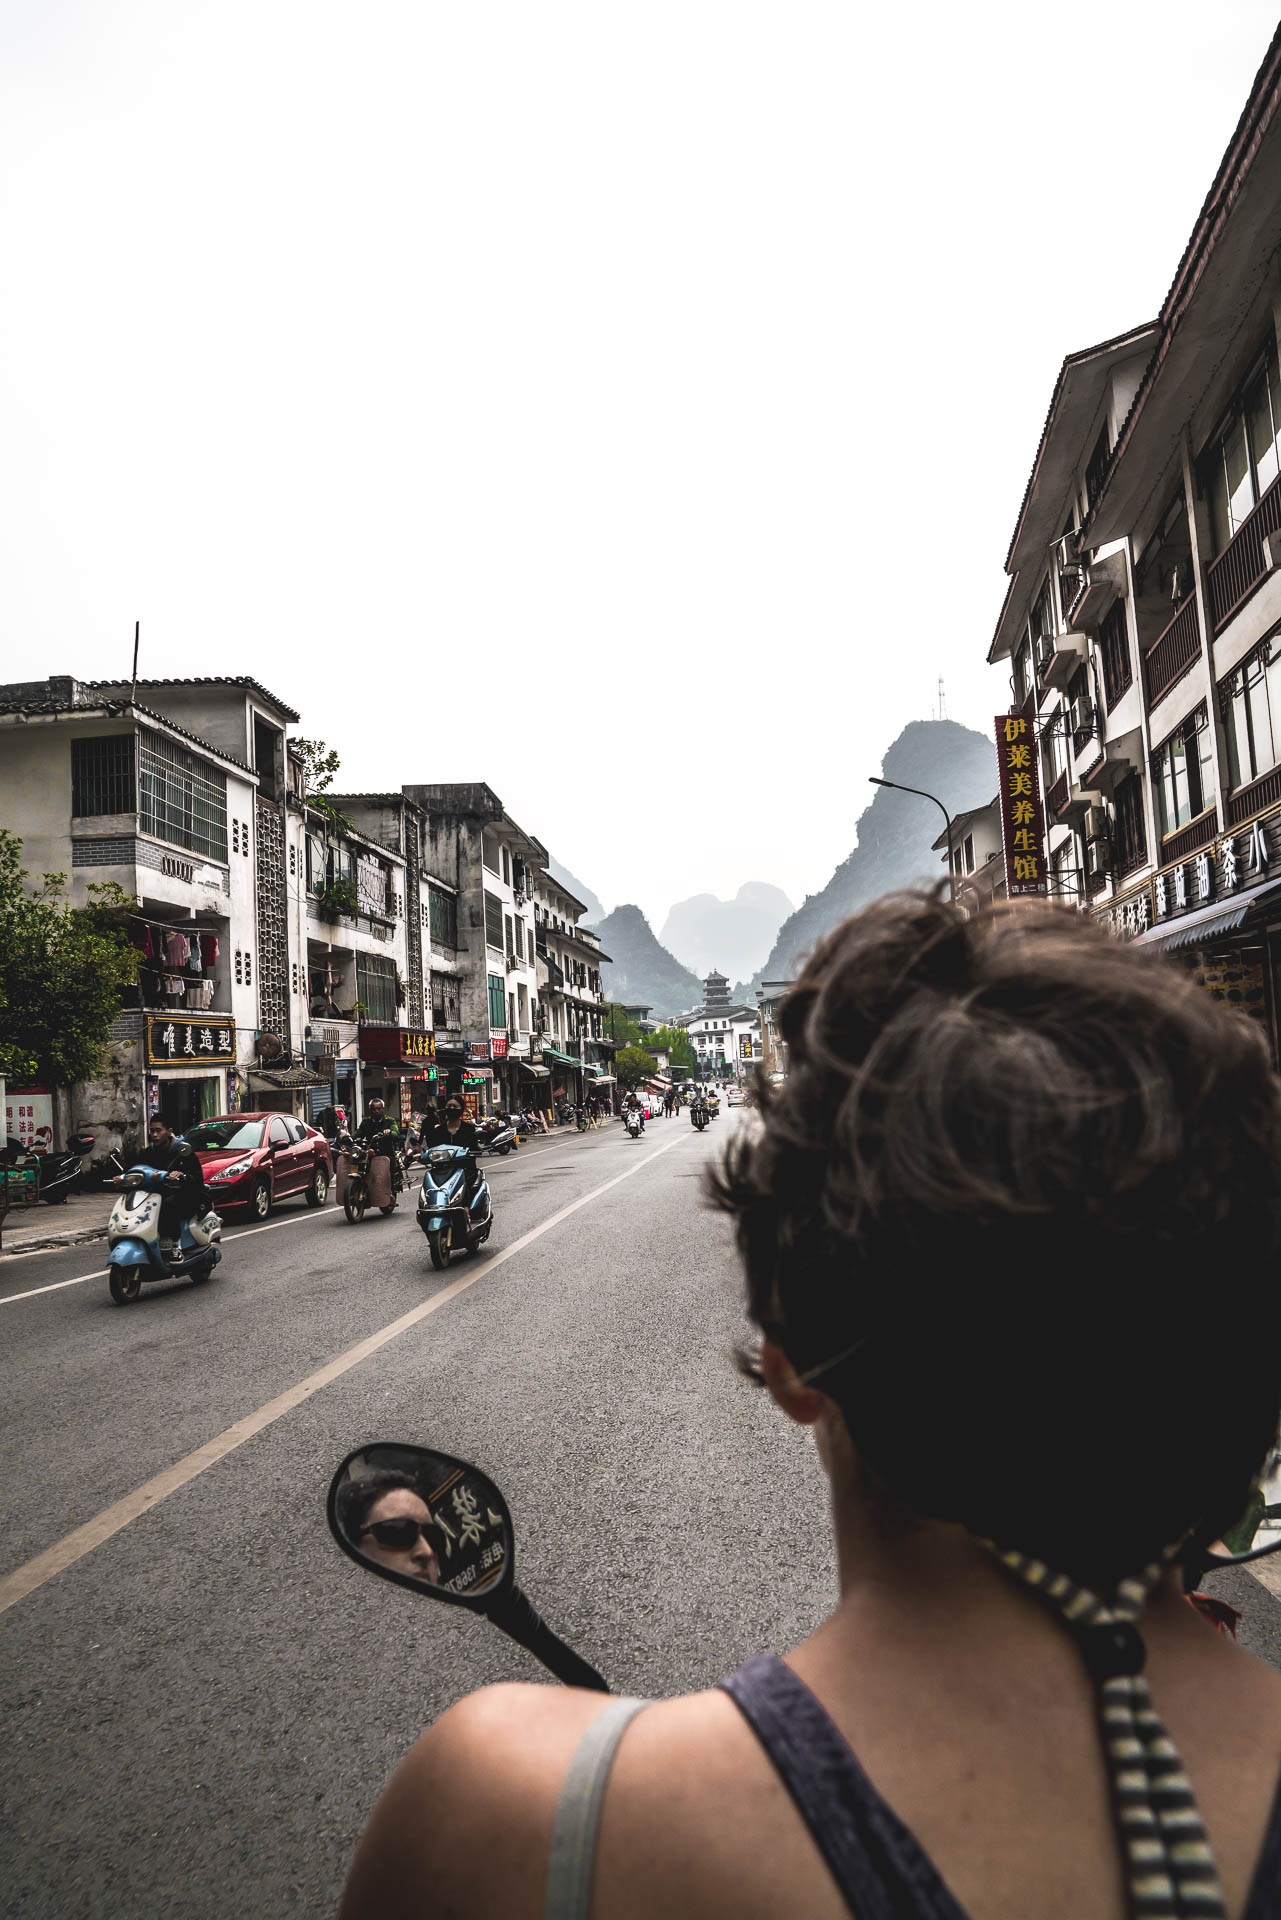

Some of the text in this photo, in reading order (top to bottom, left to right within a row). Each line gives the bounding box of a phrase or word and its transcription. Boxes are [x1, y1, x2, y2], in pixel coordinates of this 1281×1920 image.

[1003, 718, 1038, 880] 伊莱美养生馆
[19, 1105, 33, 1117] 和谐
[19, 1120, 34, 1132] 法治
